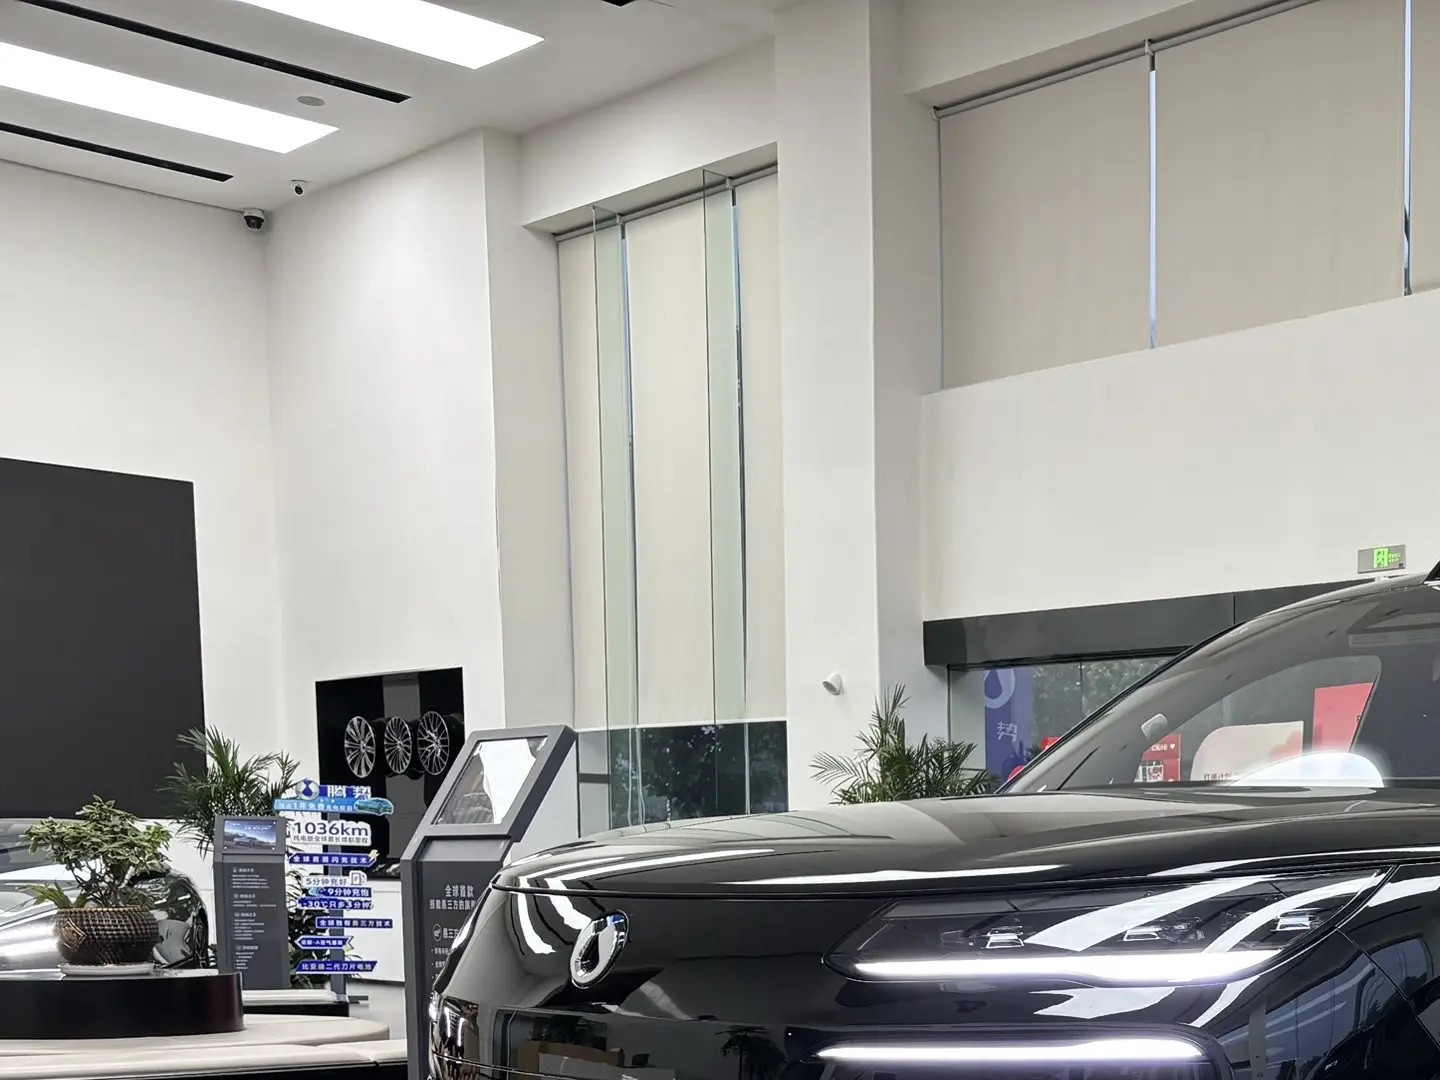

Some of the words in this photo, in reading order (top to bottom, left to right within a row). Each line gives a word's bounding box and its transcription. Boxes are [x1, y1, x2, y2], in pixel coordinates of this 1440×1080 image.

[997, 721, 1018, 742] 势
[294, 822, 369, 836] 1036km
[444, 884, 475, 898] 全球首款
